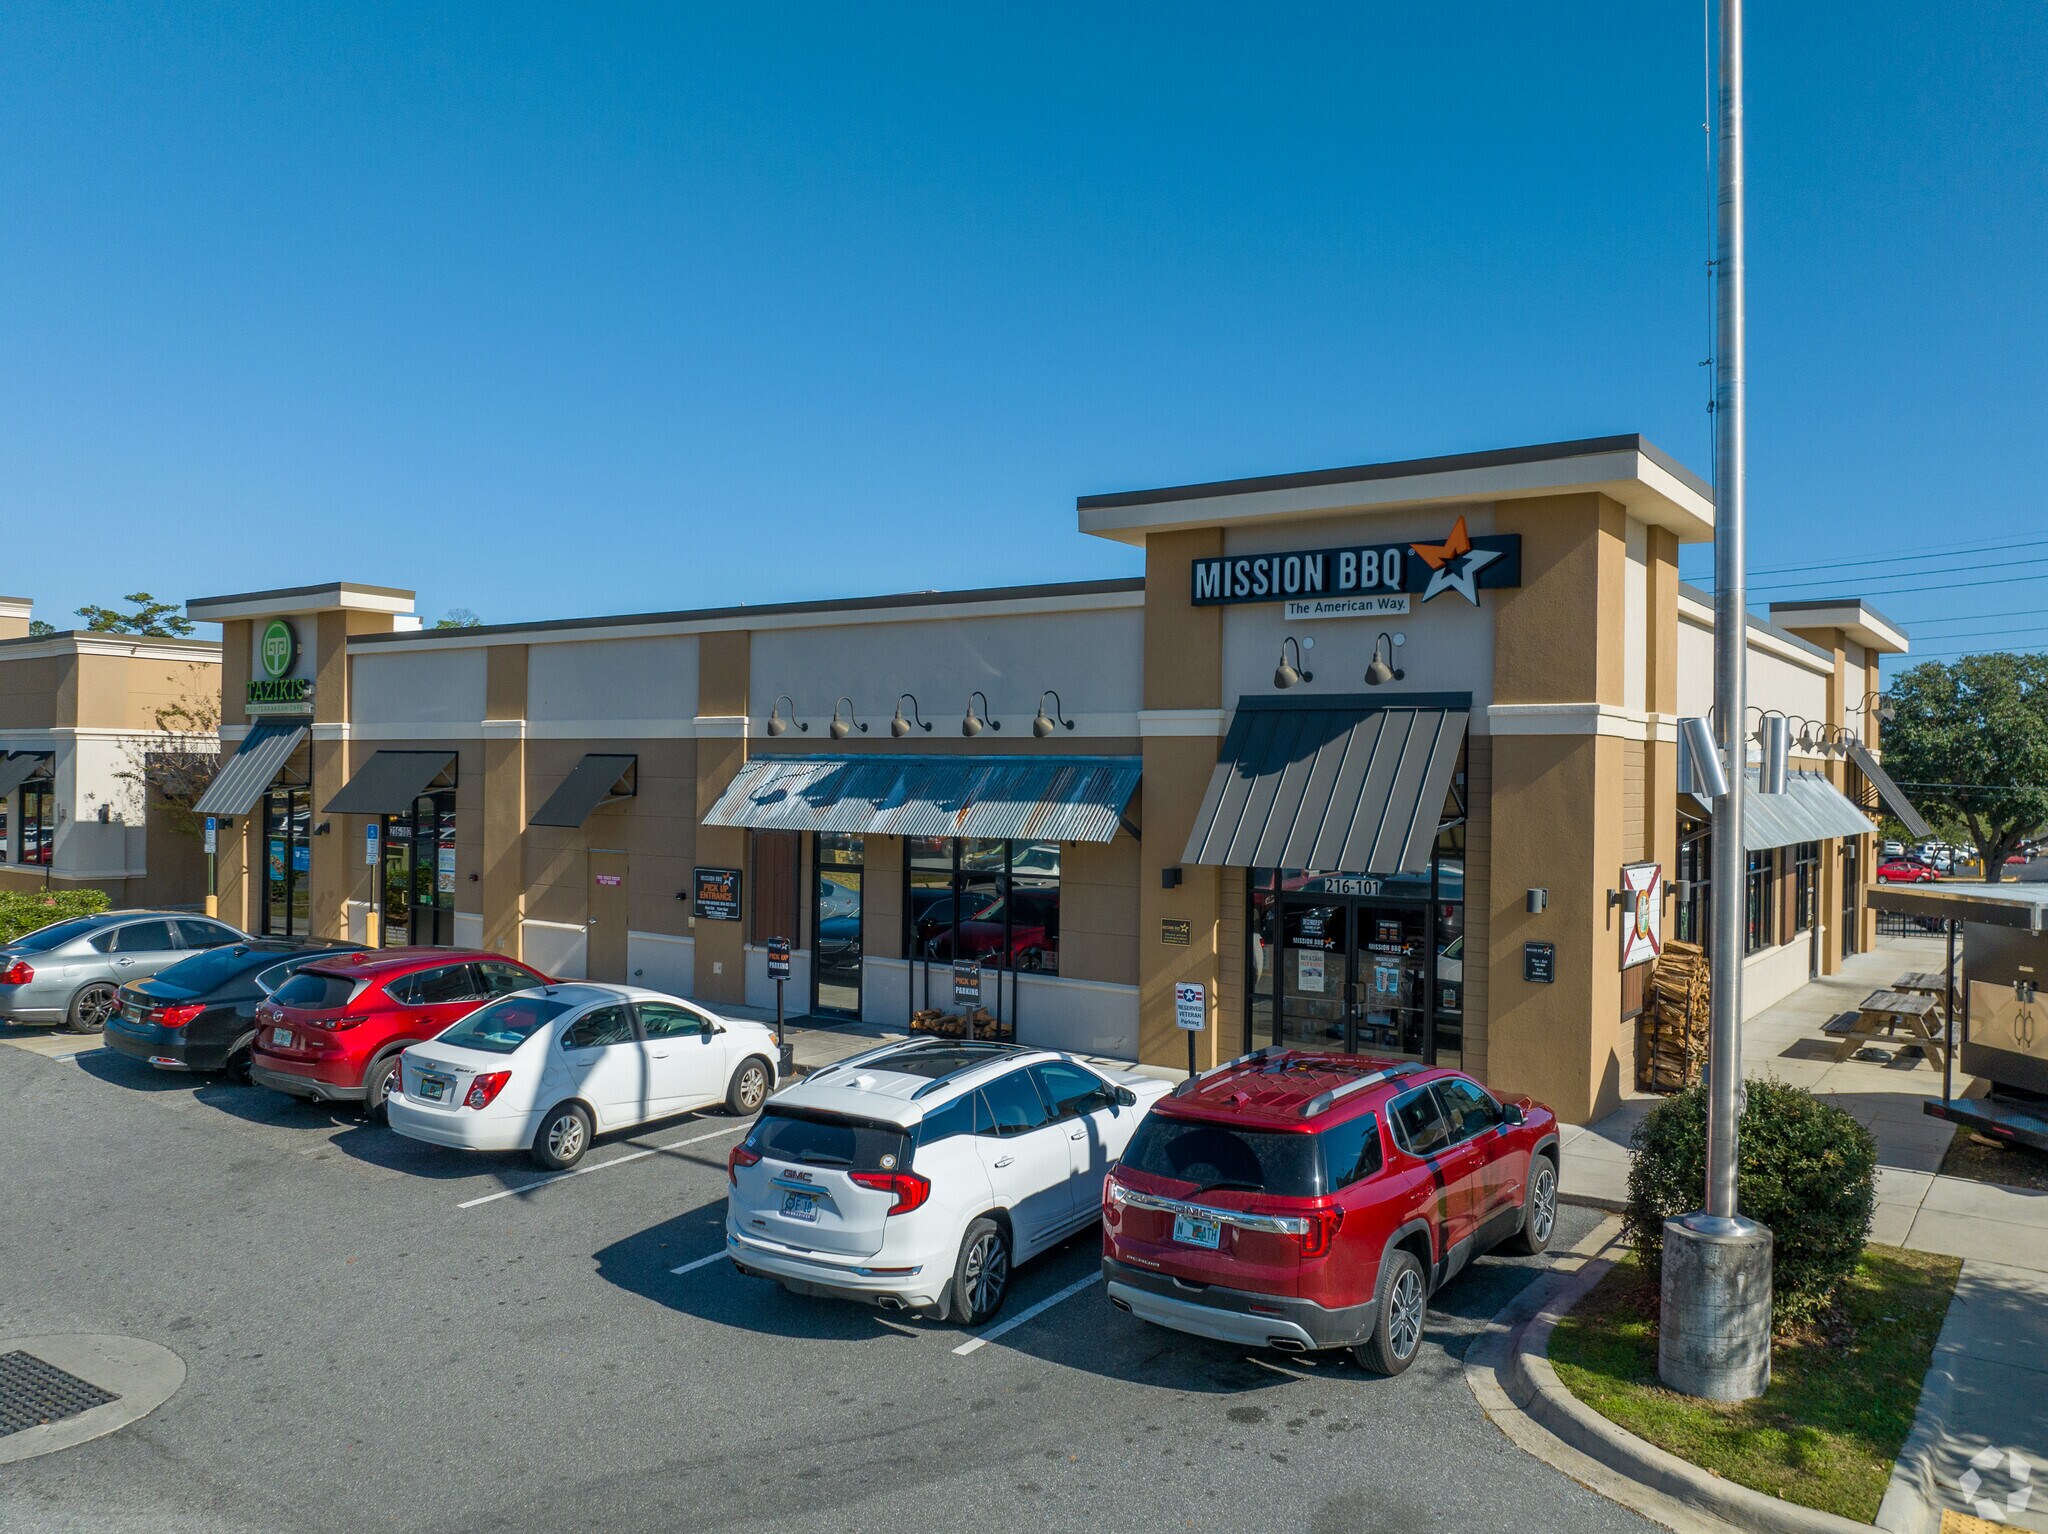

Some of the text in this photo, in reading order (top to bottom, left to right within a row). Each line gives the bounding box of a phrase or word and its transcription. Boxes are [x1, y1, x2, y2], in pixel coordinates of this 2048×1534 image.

[1196, 548, 1402, 599] MISSION BBQ
[1289, 598, 1406, 614] The American Way.
[703, 883, 729, 893] PICK UP
[1325, 878, 1379, 896] 216-101
[699, 891, 733, 901] ENTRANCE
[1292, 936, 1313, 945] MISSION
[1314, 938, 1324, 946] BBQ
[1368, 942, 1390, 951] MISSION
[1391, 944, 1402, 953] BBQ
[769, 961, 789, 970] PARKING
[955, 977, 979, 986] PICK UP
[955, 986, 979, 996] PARKING
[1178, 1004, 1203, 1012] RESERVED
[1179, 1011, 1202, 1019] VETERAN
[1181, 1019, 1200, 1027] Parking
[783, 1169, 813, 1182] GMC
[1174, 1205, 1213, 1219] GMC
[1126, 1254, 1160, 1267] ACADIA
